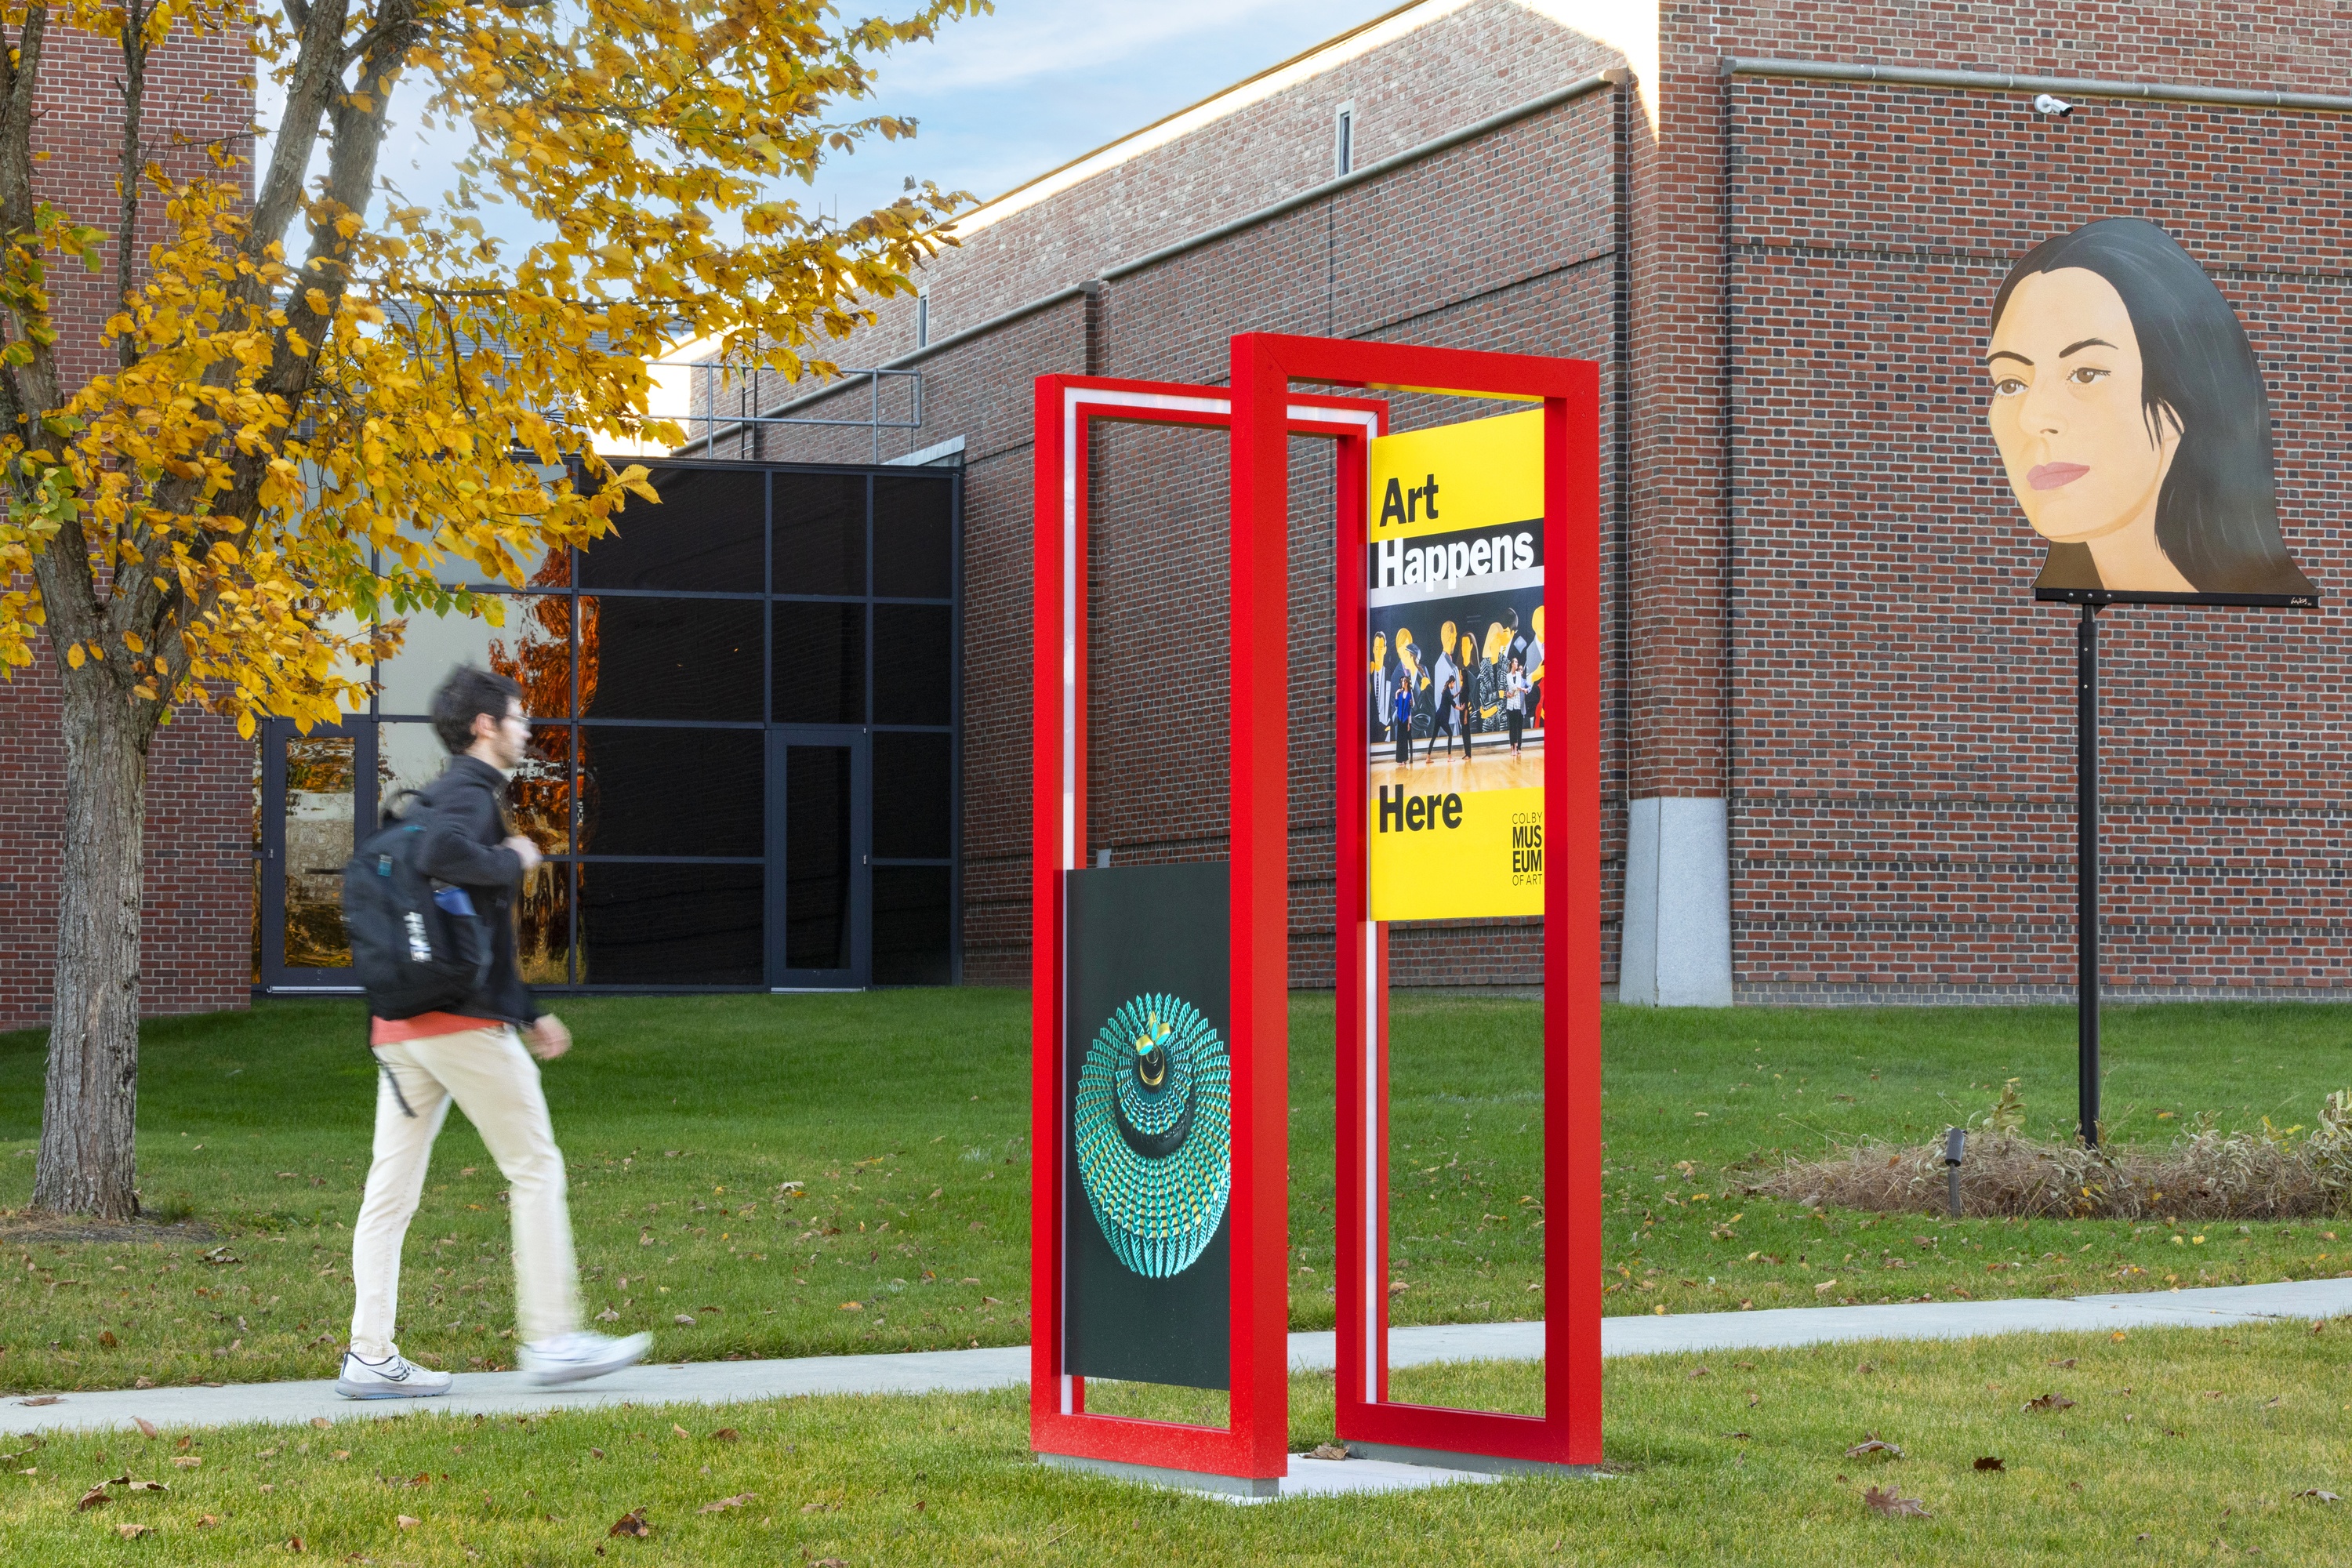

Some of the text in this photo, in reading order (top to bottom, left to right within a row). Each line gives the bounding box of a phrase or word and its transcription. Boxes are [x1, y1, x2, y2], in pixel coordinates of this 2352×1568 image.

[1379, 474, 1439, 528] Art
[1377, 532, 1534, 593] Happens
[1379, 784, 1463, 833] Here
[1512, 811, 1543, 825] COLBY
[1512, 824, 1542, 849] MUS
[1512, 849, 1542, 873] EUM
[1512, 873, 1543, 886] OF ART
